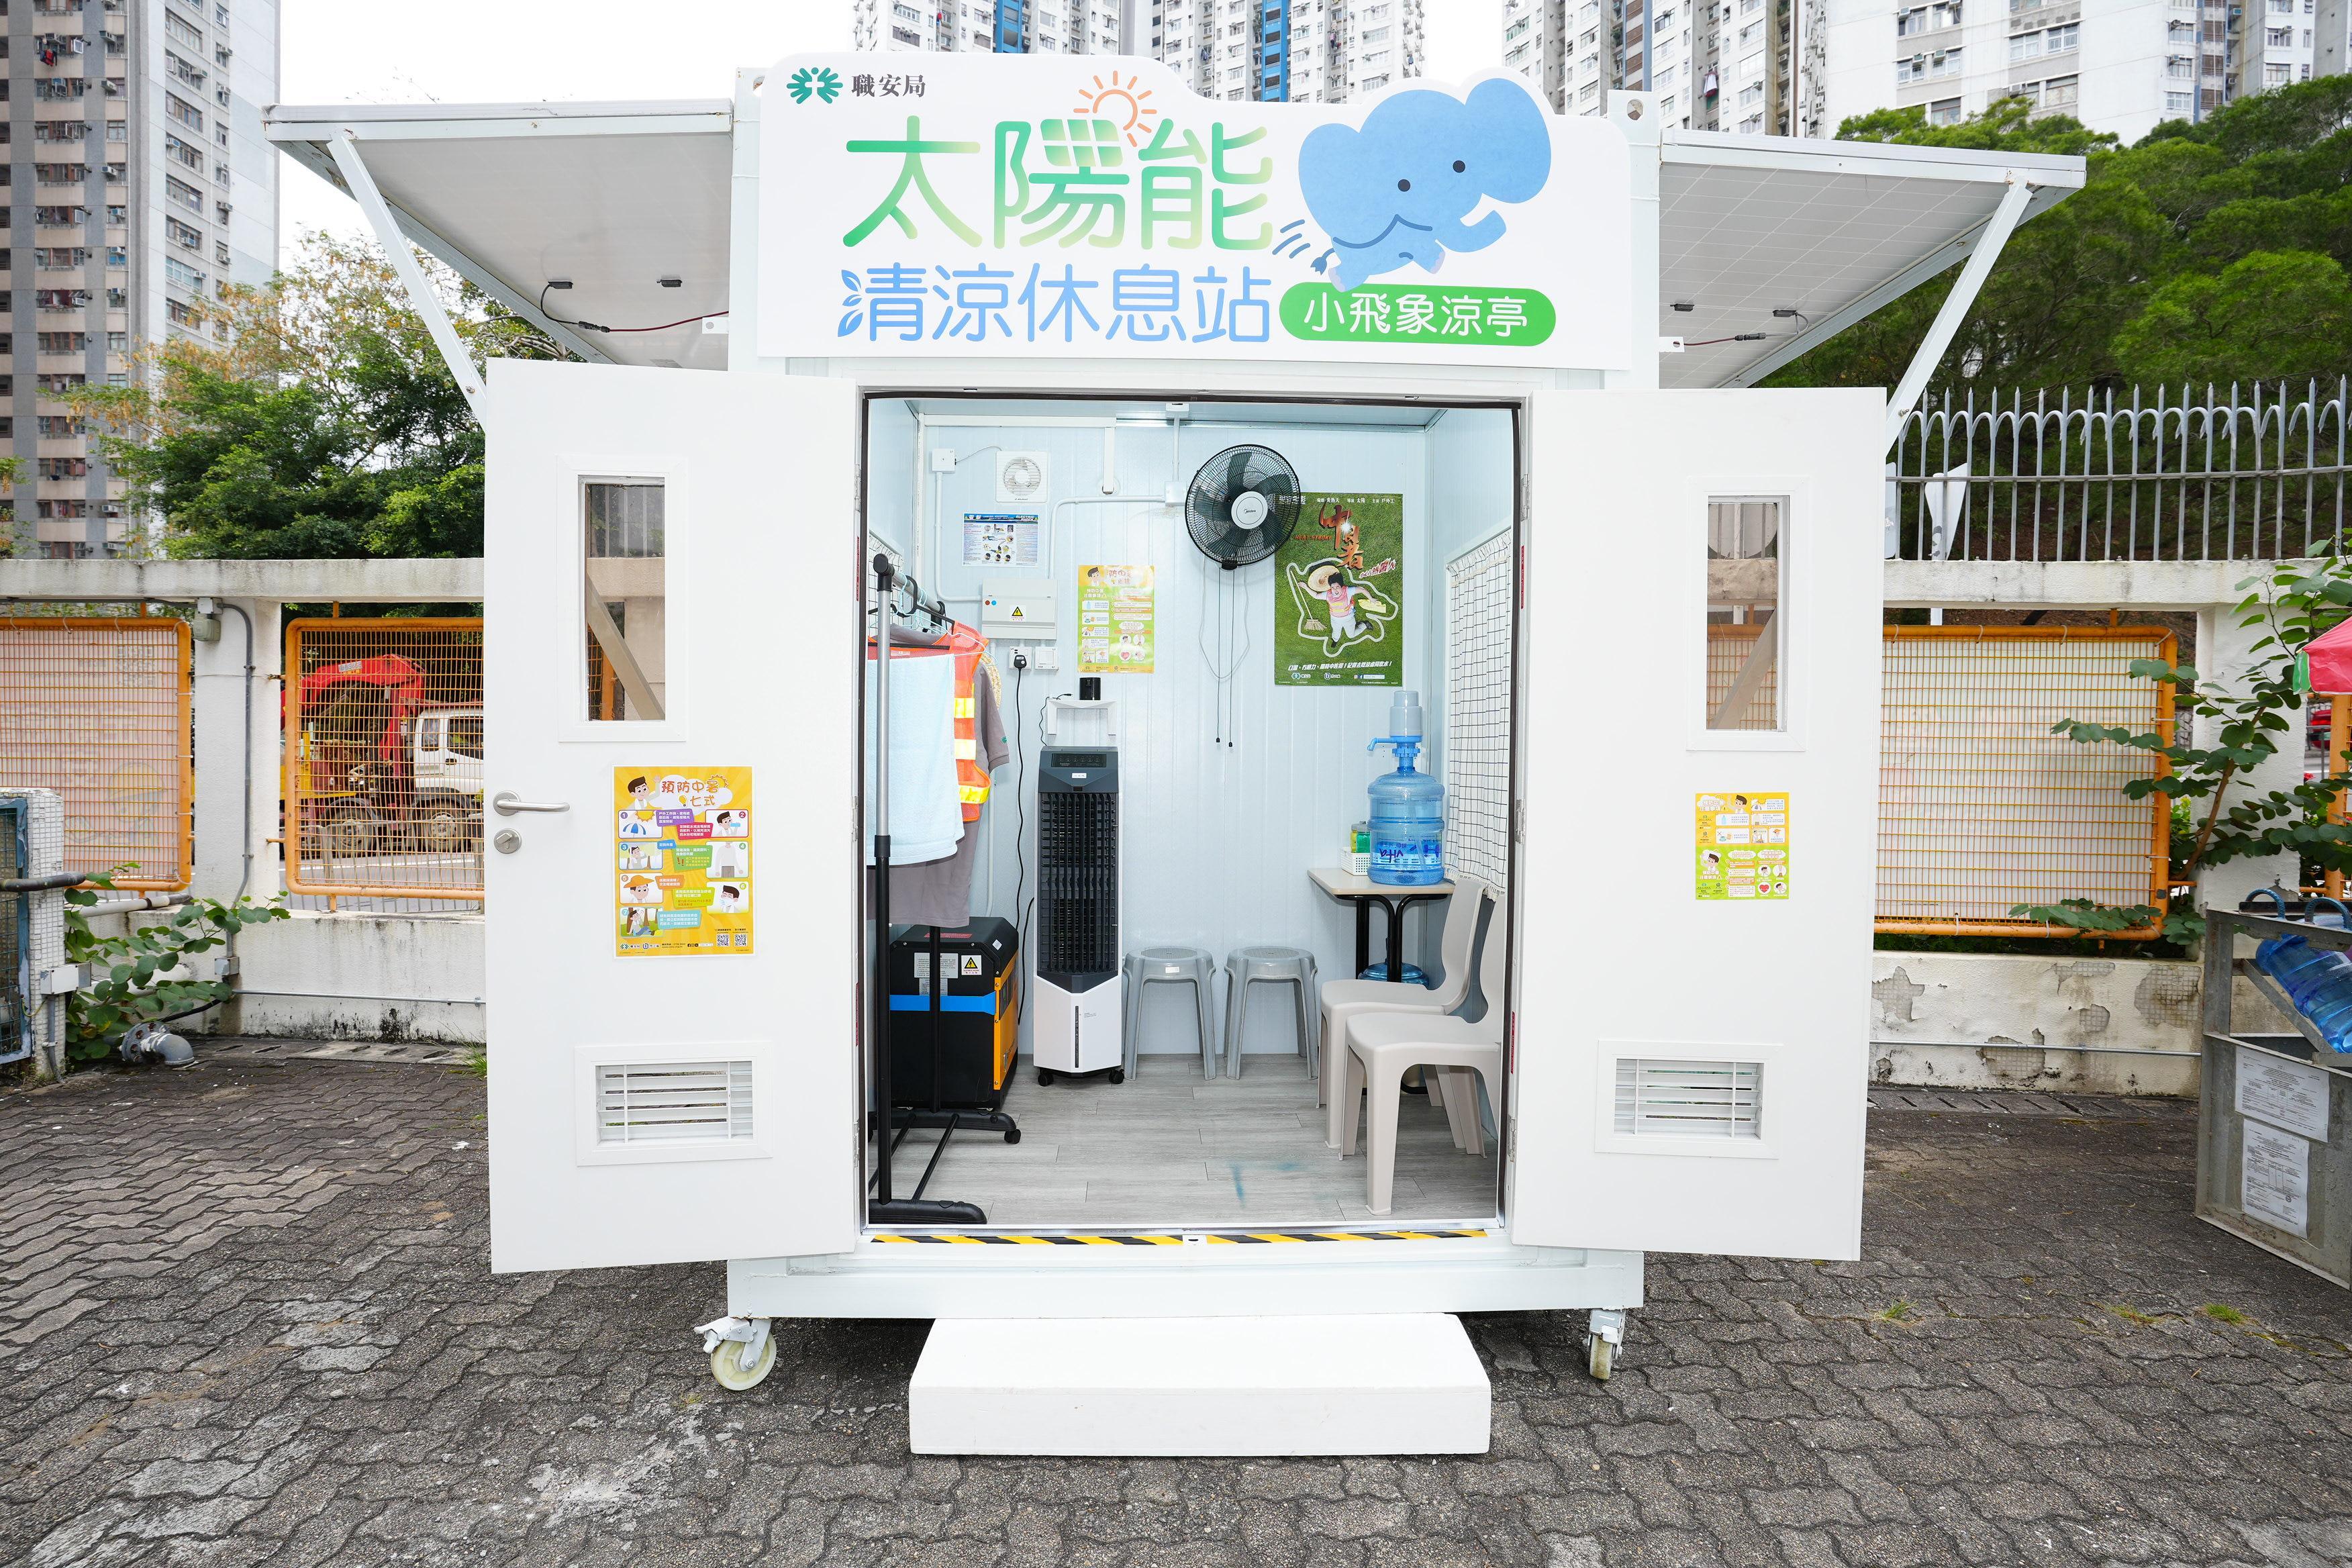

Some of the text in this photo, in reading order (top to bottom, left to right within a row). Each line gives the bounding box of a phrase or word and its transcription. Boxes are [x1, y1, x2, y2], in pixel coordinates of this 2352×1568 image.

[852, 74, 926, 97] 職安局
[843, 115, 1273, 250] 太陽能
[838, 262, 1271, 343] 清涼休息站
[1304, 292, 1528, 337] 小飛象涼亭
[661, 780, 719, 793] 預防中暑
[690, 795, 715, 807] 七式
